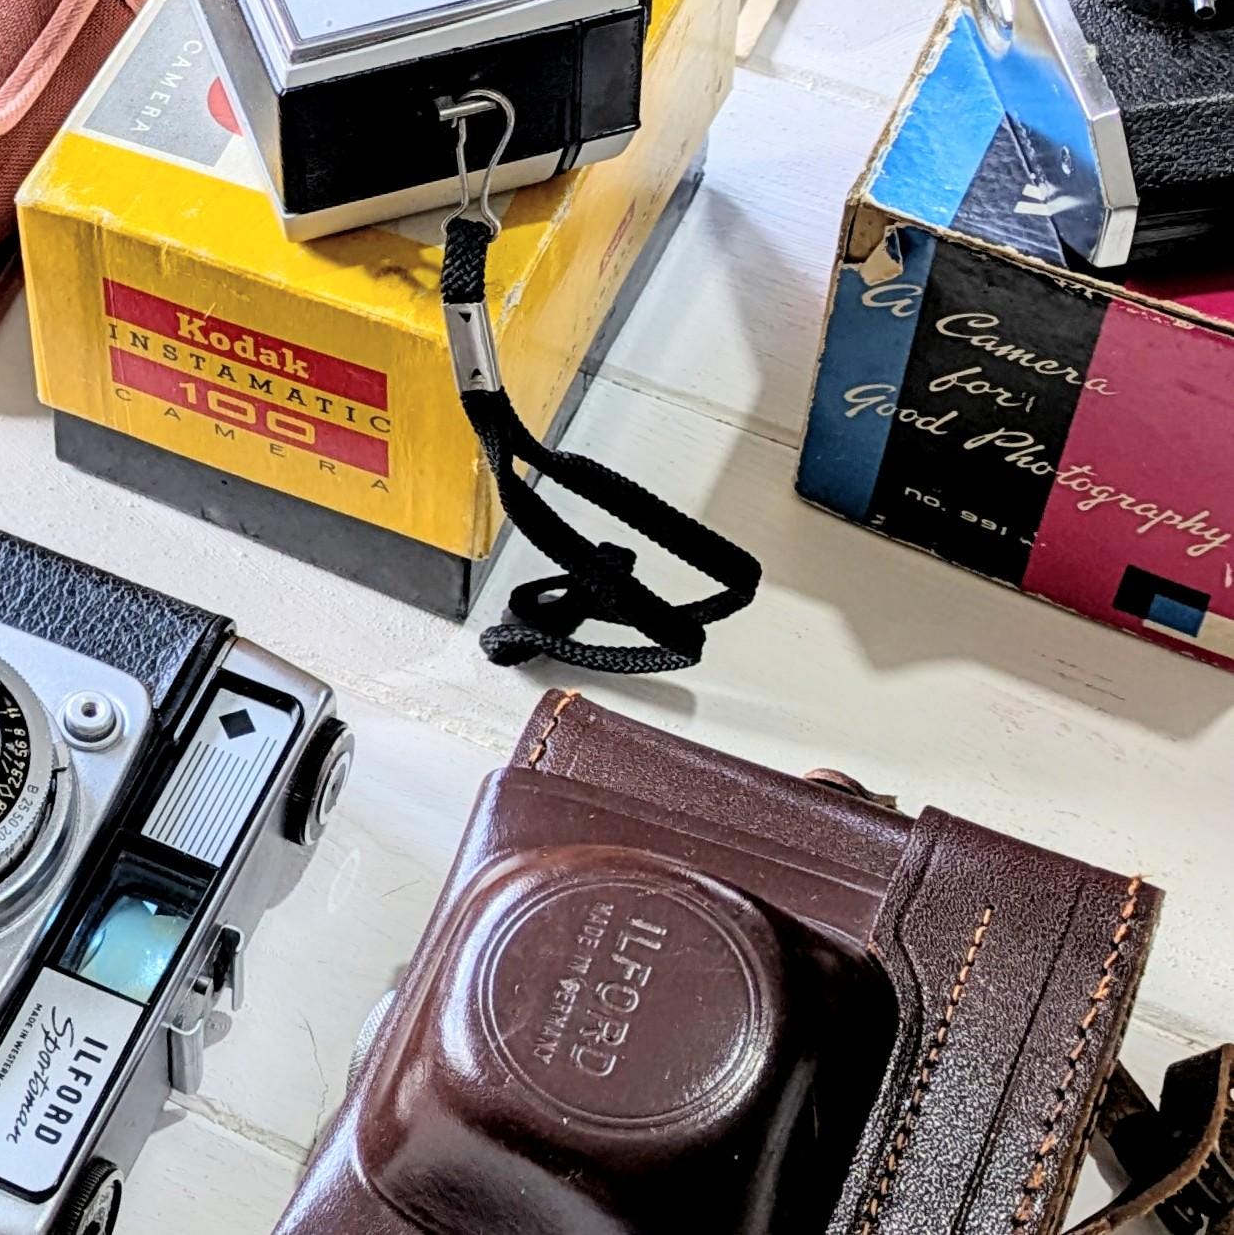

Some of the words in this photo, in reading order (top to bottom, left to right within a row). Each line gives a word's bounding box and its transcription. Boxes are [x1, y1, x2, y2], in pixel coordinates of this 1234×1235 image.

[129, 39, 203, 132] CAMERA
[108, 323, 391, 434] INSTAMATIC
[176, 312, 310, 379] Kodak
[935, 312, 1120, 397] Camera
[178, 381, 316, 445] 100
[928, 366, 1024, 409] for
[115, 388, 390, 494] CAMERA
[843, 383, 959, 437] Good
[962, 425, 1233, 558] Photography
[904, 486, 947, 513] no.
[960, 510, 1007, 536] 991
[8, 812, 24, 829] 50
[18, 797, 34, 813] 25
[577, 901, 615, 950] MADE
[567, 955, 593, 974] IN
[570, 918, 668, 1077] ILFORD
[29, 1003, 43, 1029] MADE
[533, 978, 581, 1065] GERMANY
[0, 1039, 24, 1081] WESTERN
[6, 1006, 75, 1144] Sportsman
[34, 1036, 109, 1145] ILFORD
